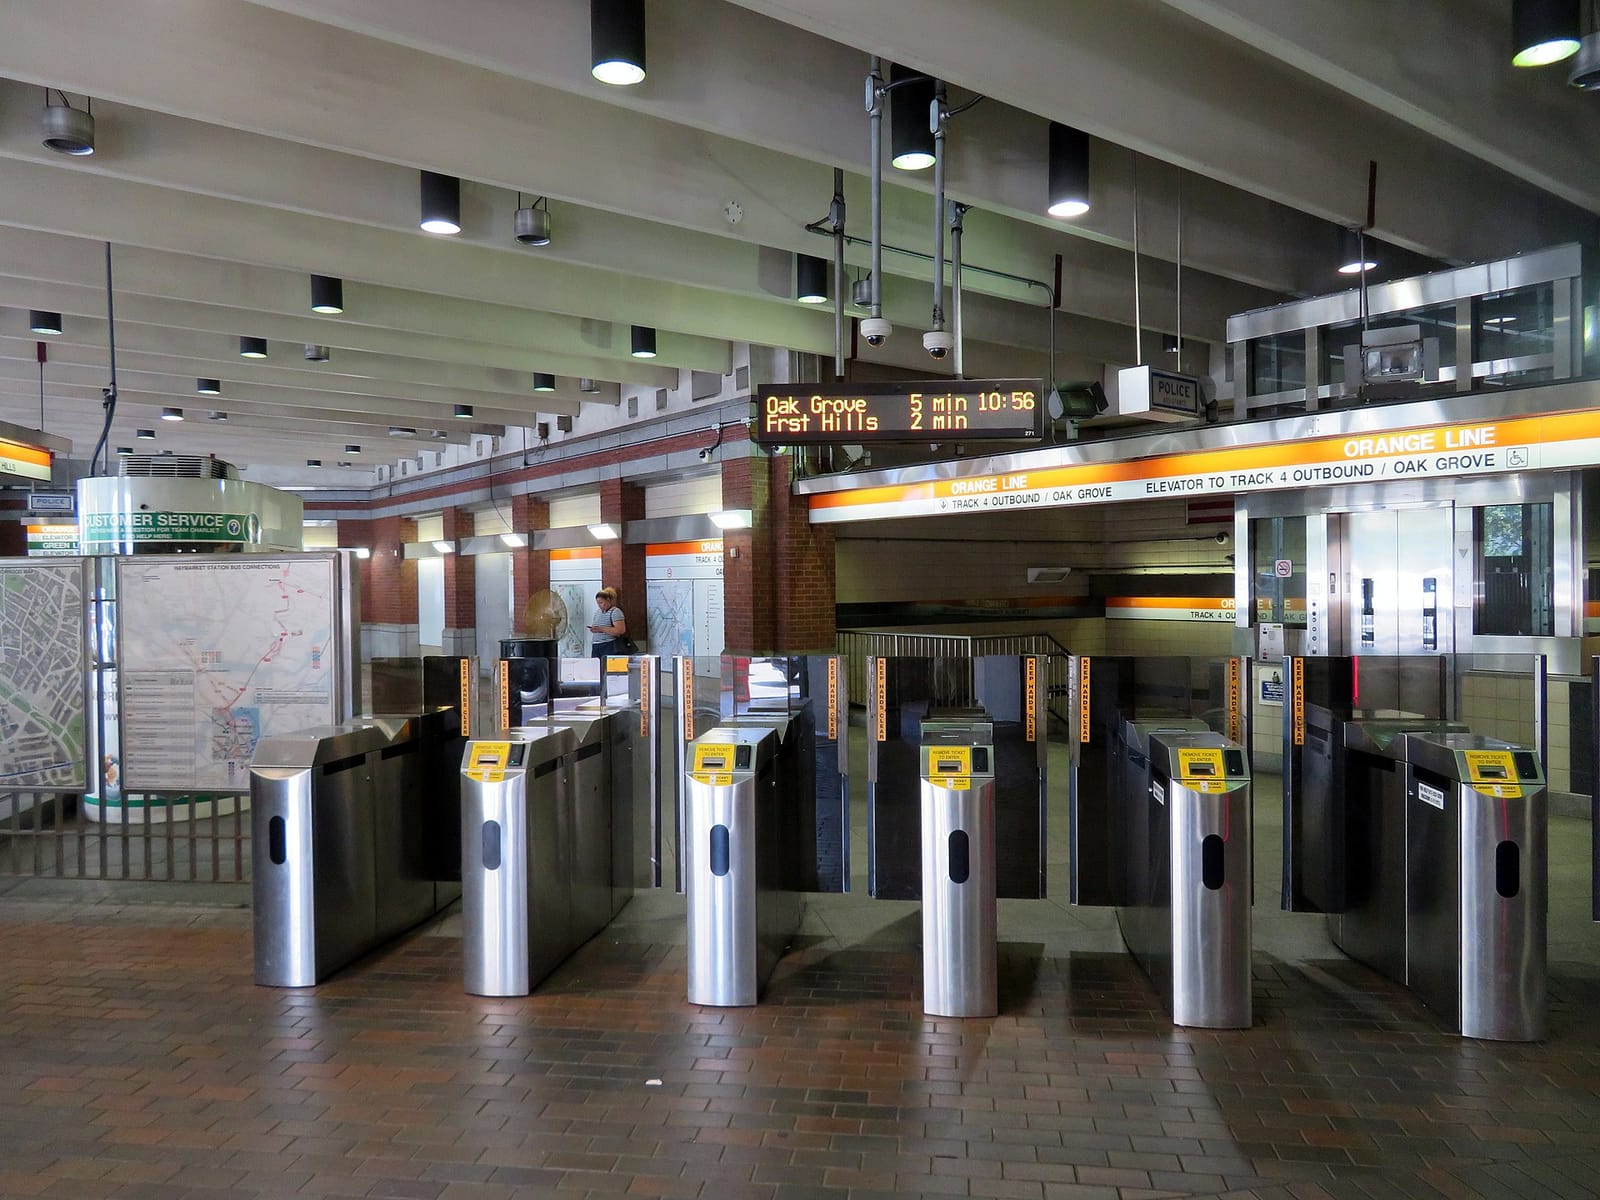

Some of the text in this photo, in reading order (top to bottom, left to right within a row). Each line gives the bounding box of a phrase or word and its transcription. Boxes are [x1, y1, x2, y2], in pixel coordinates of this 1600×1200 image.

[1158, 380, 1190, 398] POLICE
[766, 392, 1035, 414] Oak Grove 5 min 10:56
[766, 412, 968, 432] Frst Hills 2 min
[1344, 426, 1496, 458] ORANGE LINE
[1146, 453, 1495, 494] ELEVATOR TO TRACK 4 OUTBOUND / OAK GROVE
[951, 475, 1028, 495] ORANGE LINE
[952, 498, 979, 509] TRACK
[983, 498, 988, 506] 4
[992, 492, 1040, 506] OUTBOUND
[1052, 490, 1073, 501] OAK
[1077, 486, 1112, 499] GROVE
[157, 514, 224, 527] SERVICE
